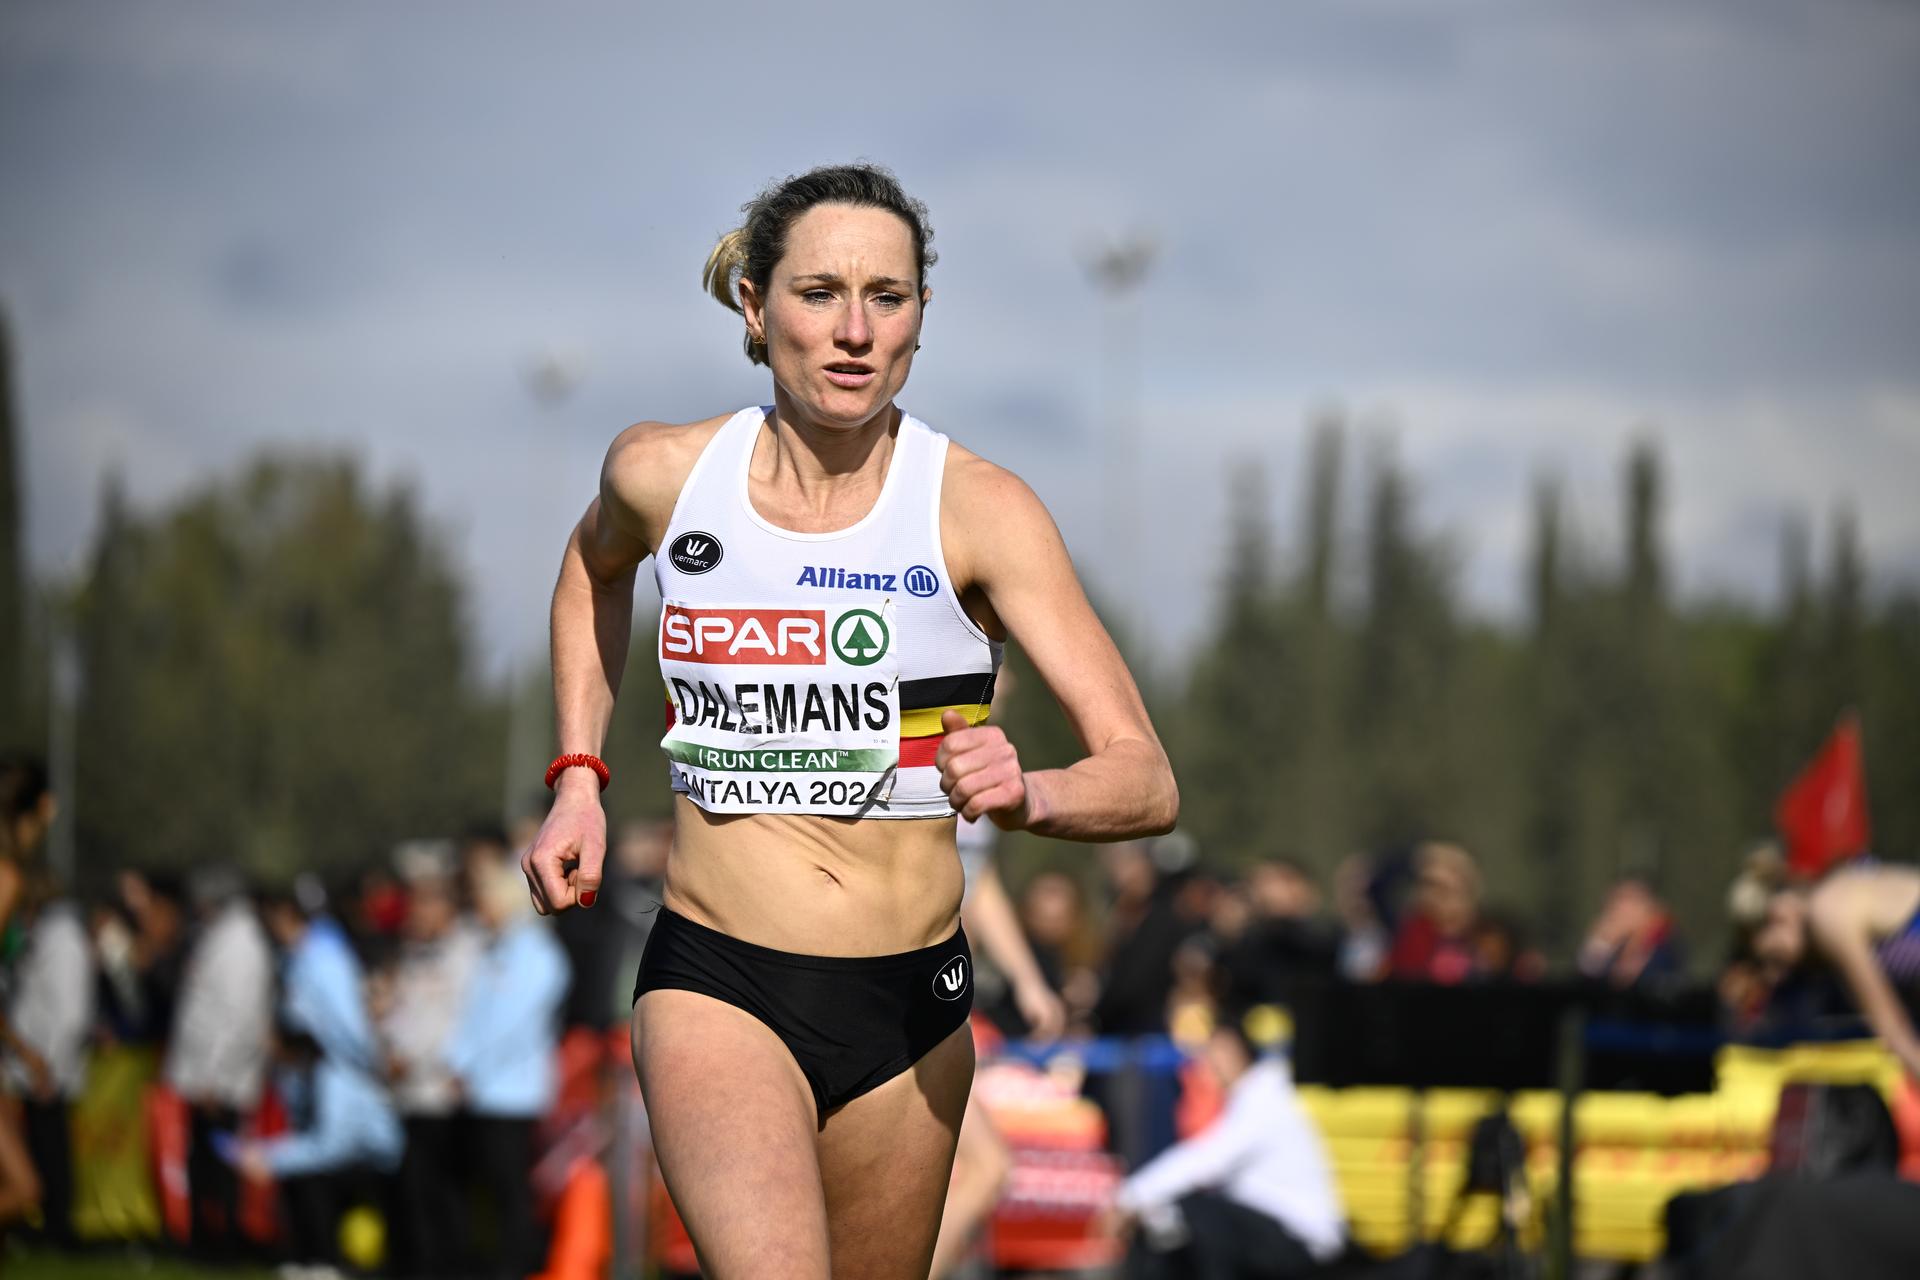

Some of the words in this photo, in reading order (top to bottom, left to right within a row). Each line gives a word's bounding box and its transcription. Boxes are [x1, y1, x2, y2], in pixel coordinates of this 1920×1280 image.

[674, 553, 709, 568] vermarc
[796, 566, 897, 592] Allianz
[665, 613, 821, 657] SPAR
[671, 677, 891, 735] DALEMANS
[706, 750, 755, 769] RUN
